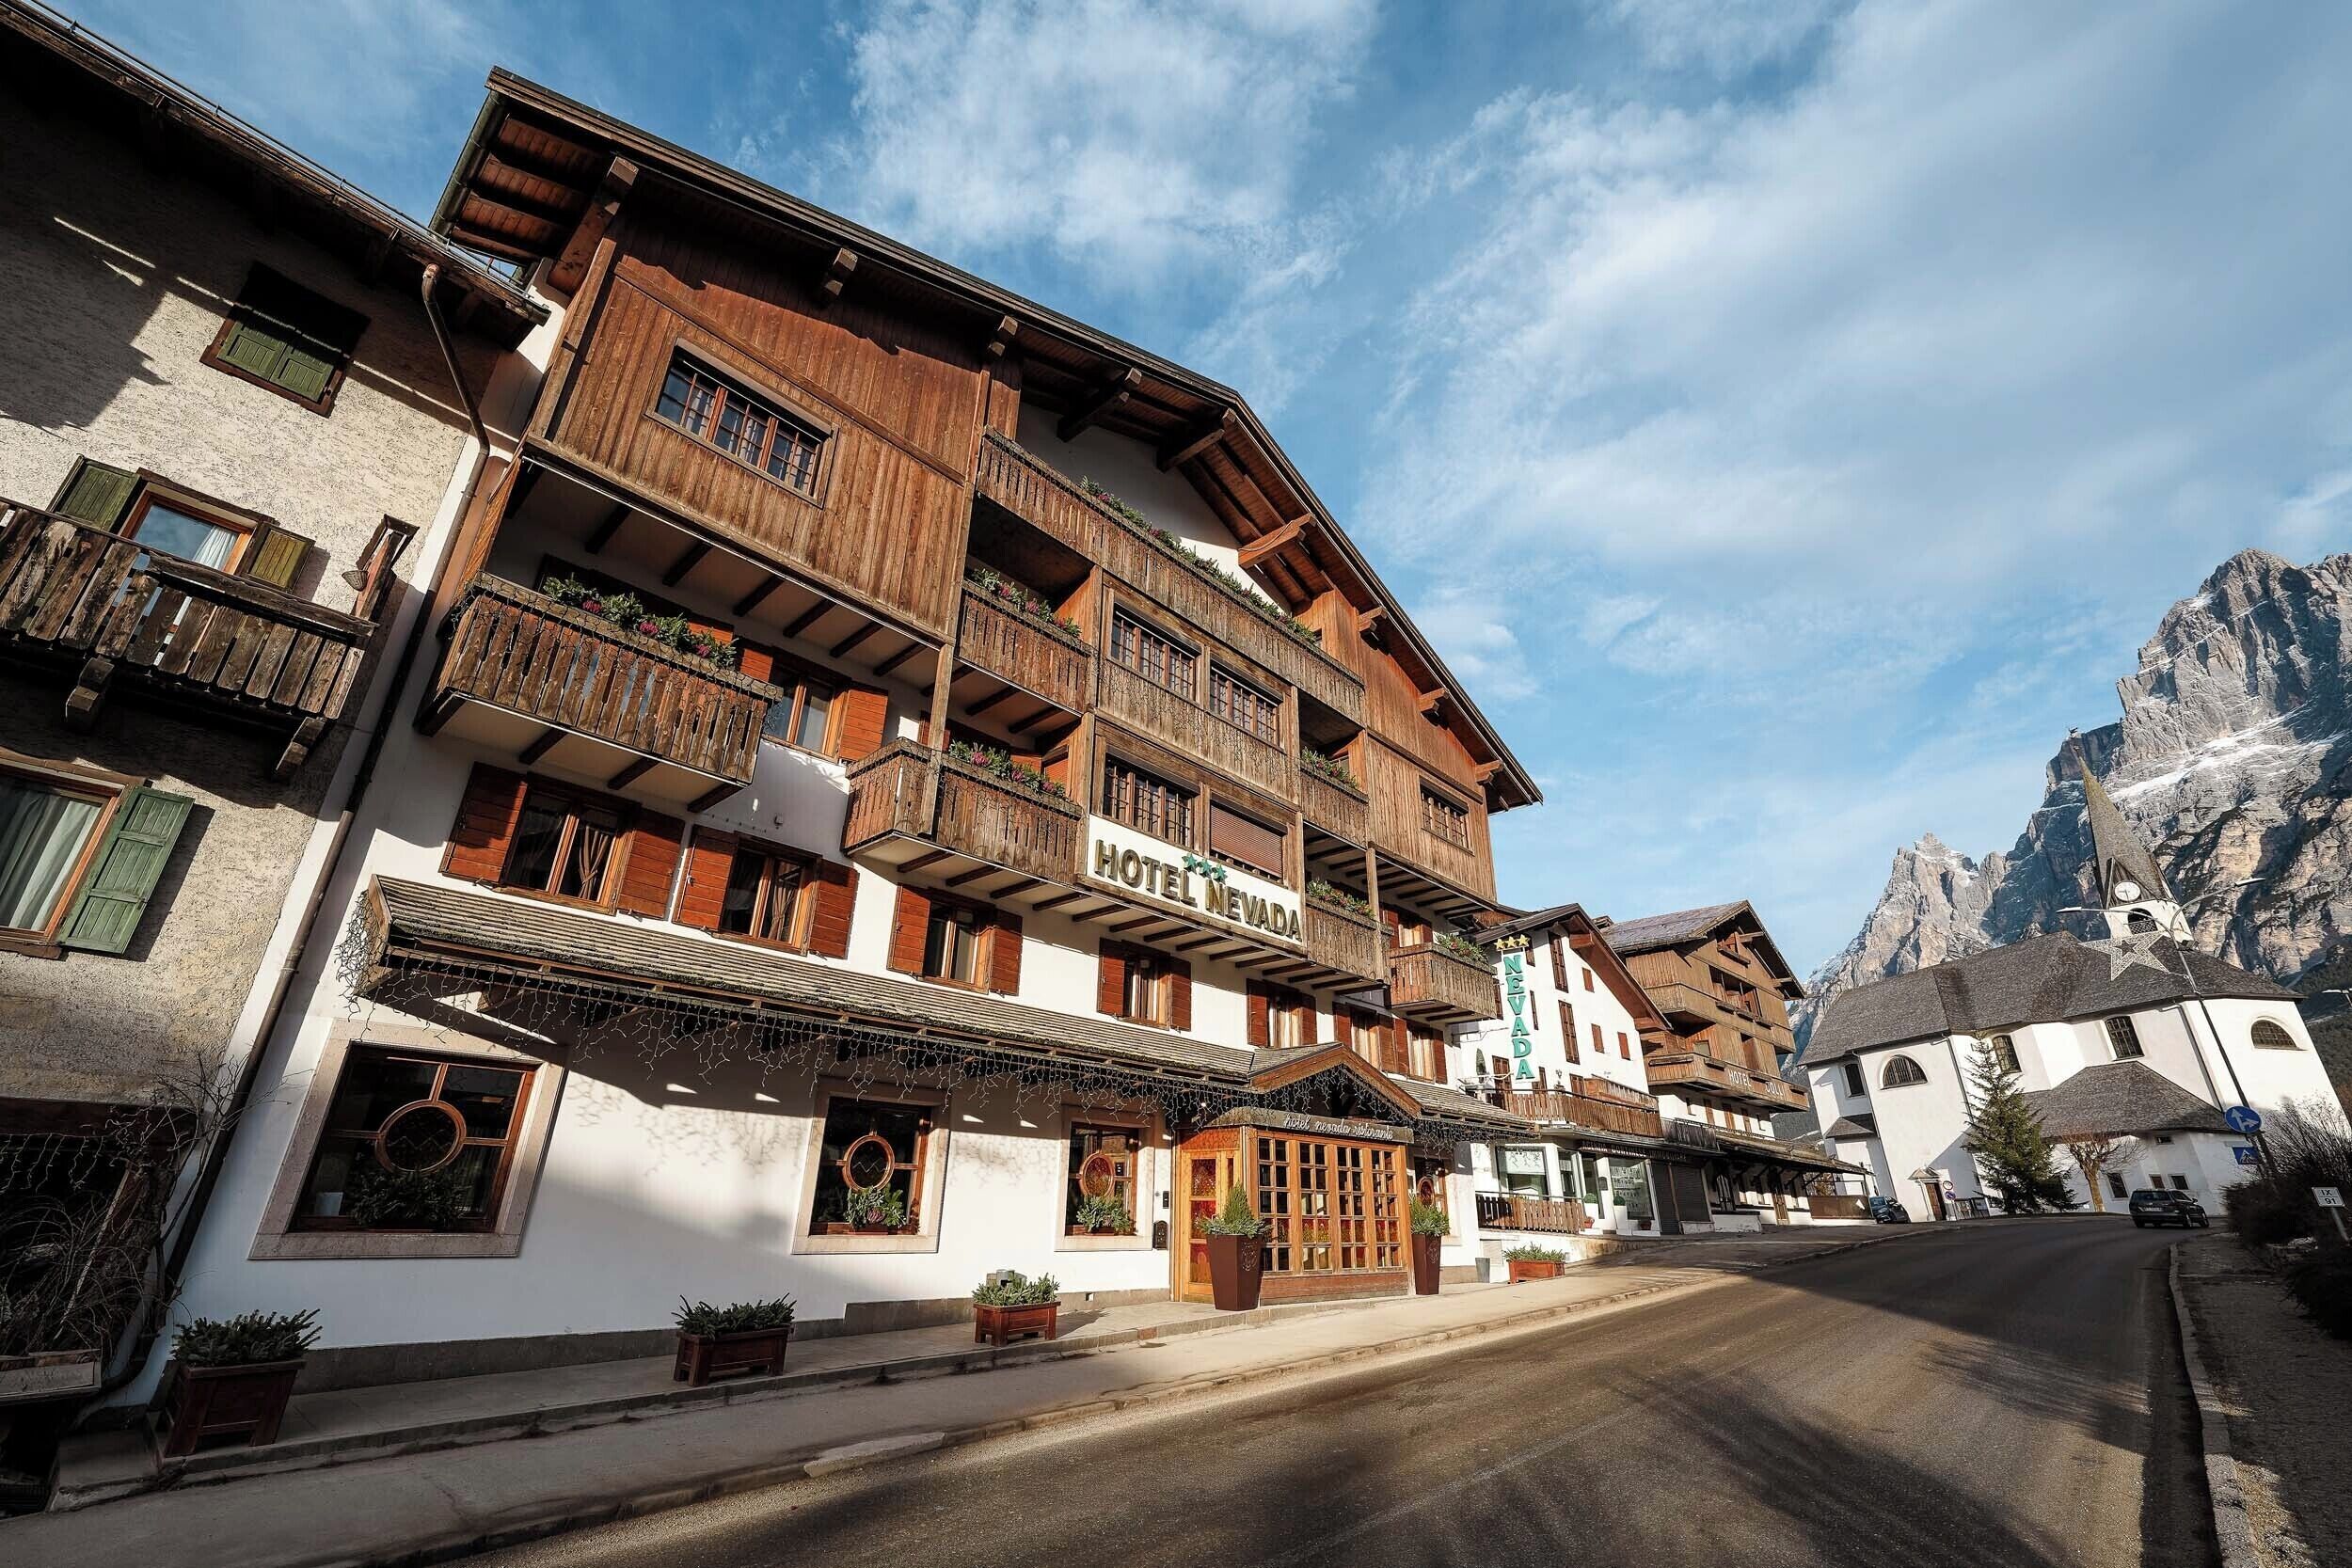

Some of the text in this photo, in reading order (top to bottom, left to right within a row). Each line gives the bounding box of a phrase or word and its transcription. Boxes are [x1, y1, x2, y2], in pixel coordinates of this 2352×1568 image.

[1094, 839, 1303, 942] HOTEL NEVADA
[1503, 954, 1535, 1081] NEVADA
[1727, 1069, 1752, 1088] HOTEL
[1283, 1113, 1311, 1131] hotel
[1315, 1118, 1351, 1135] nevada
